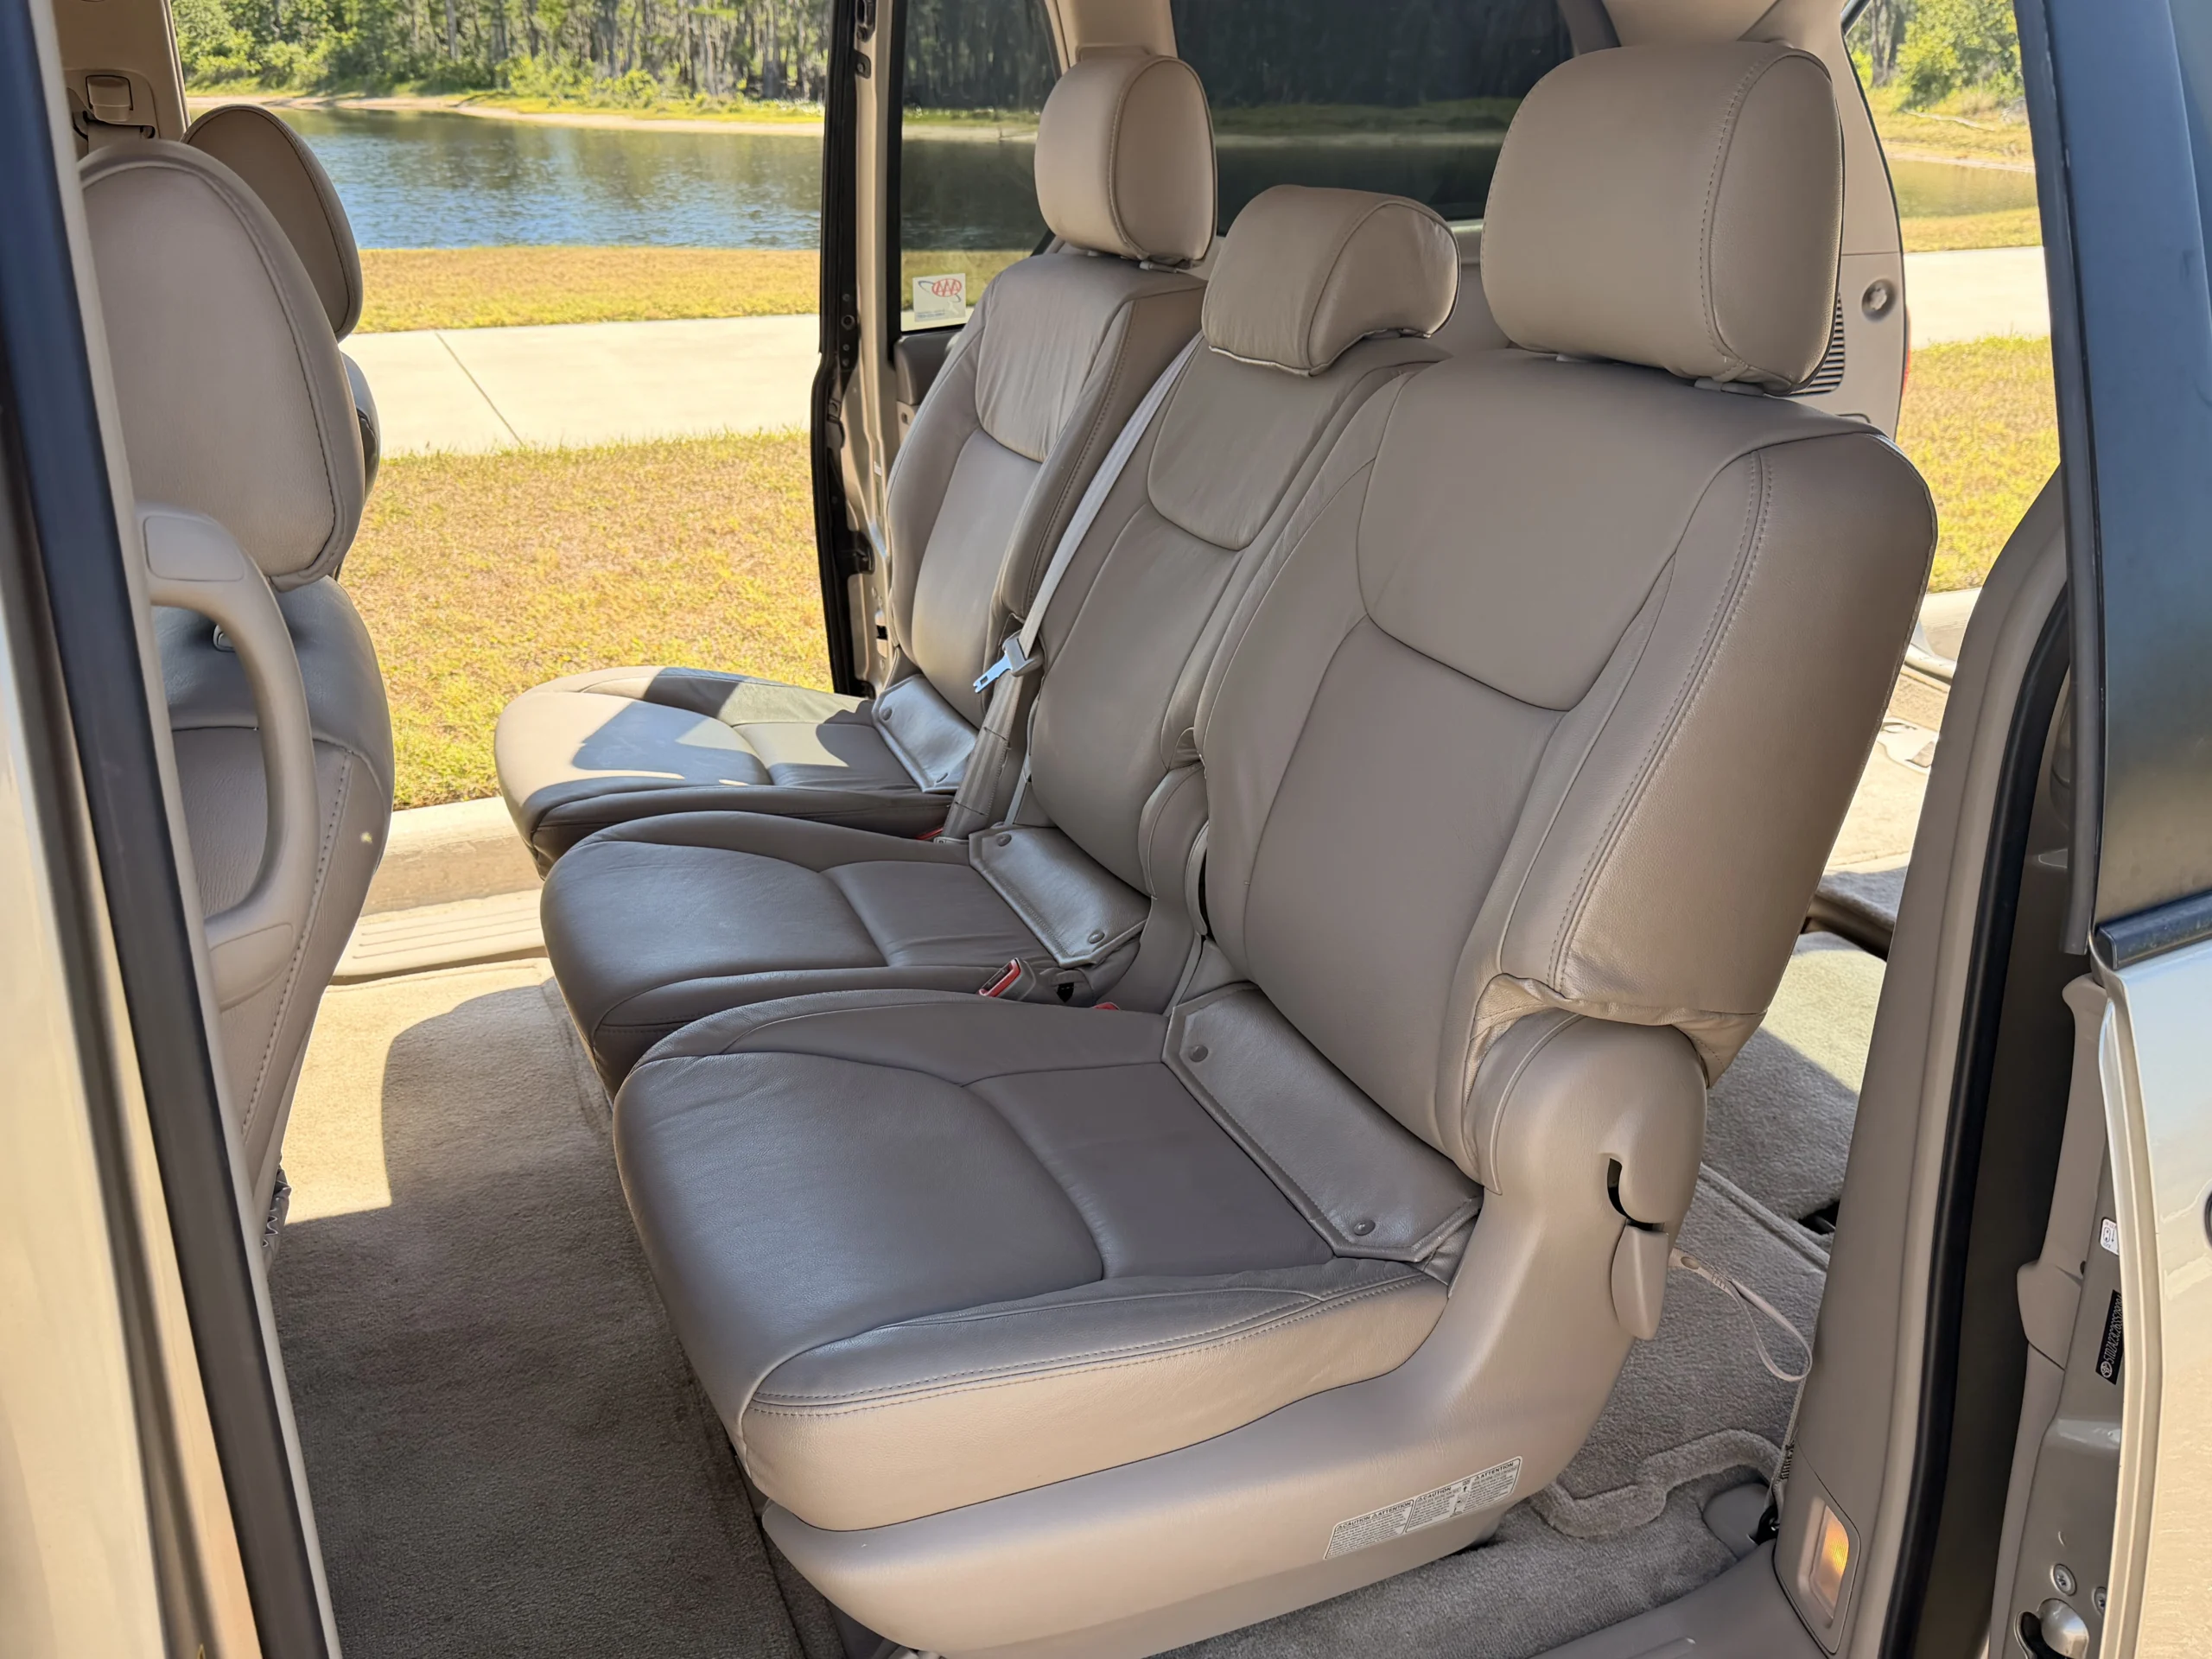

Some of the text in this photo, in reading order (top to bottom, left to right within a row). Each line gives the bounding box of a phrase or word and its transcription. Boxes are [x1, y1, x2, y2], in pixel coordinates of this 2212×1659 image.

[933, 278, 961, 297] AAA
[1480, 1462, 1514, 1479] ATTENTION
[1423, 1487, 1452, 1501] CAUTION
[1343, 1502, 1412, 1529] CAUTION ATTENTION
